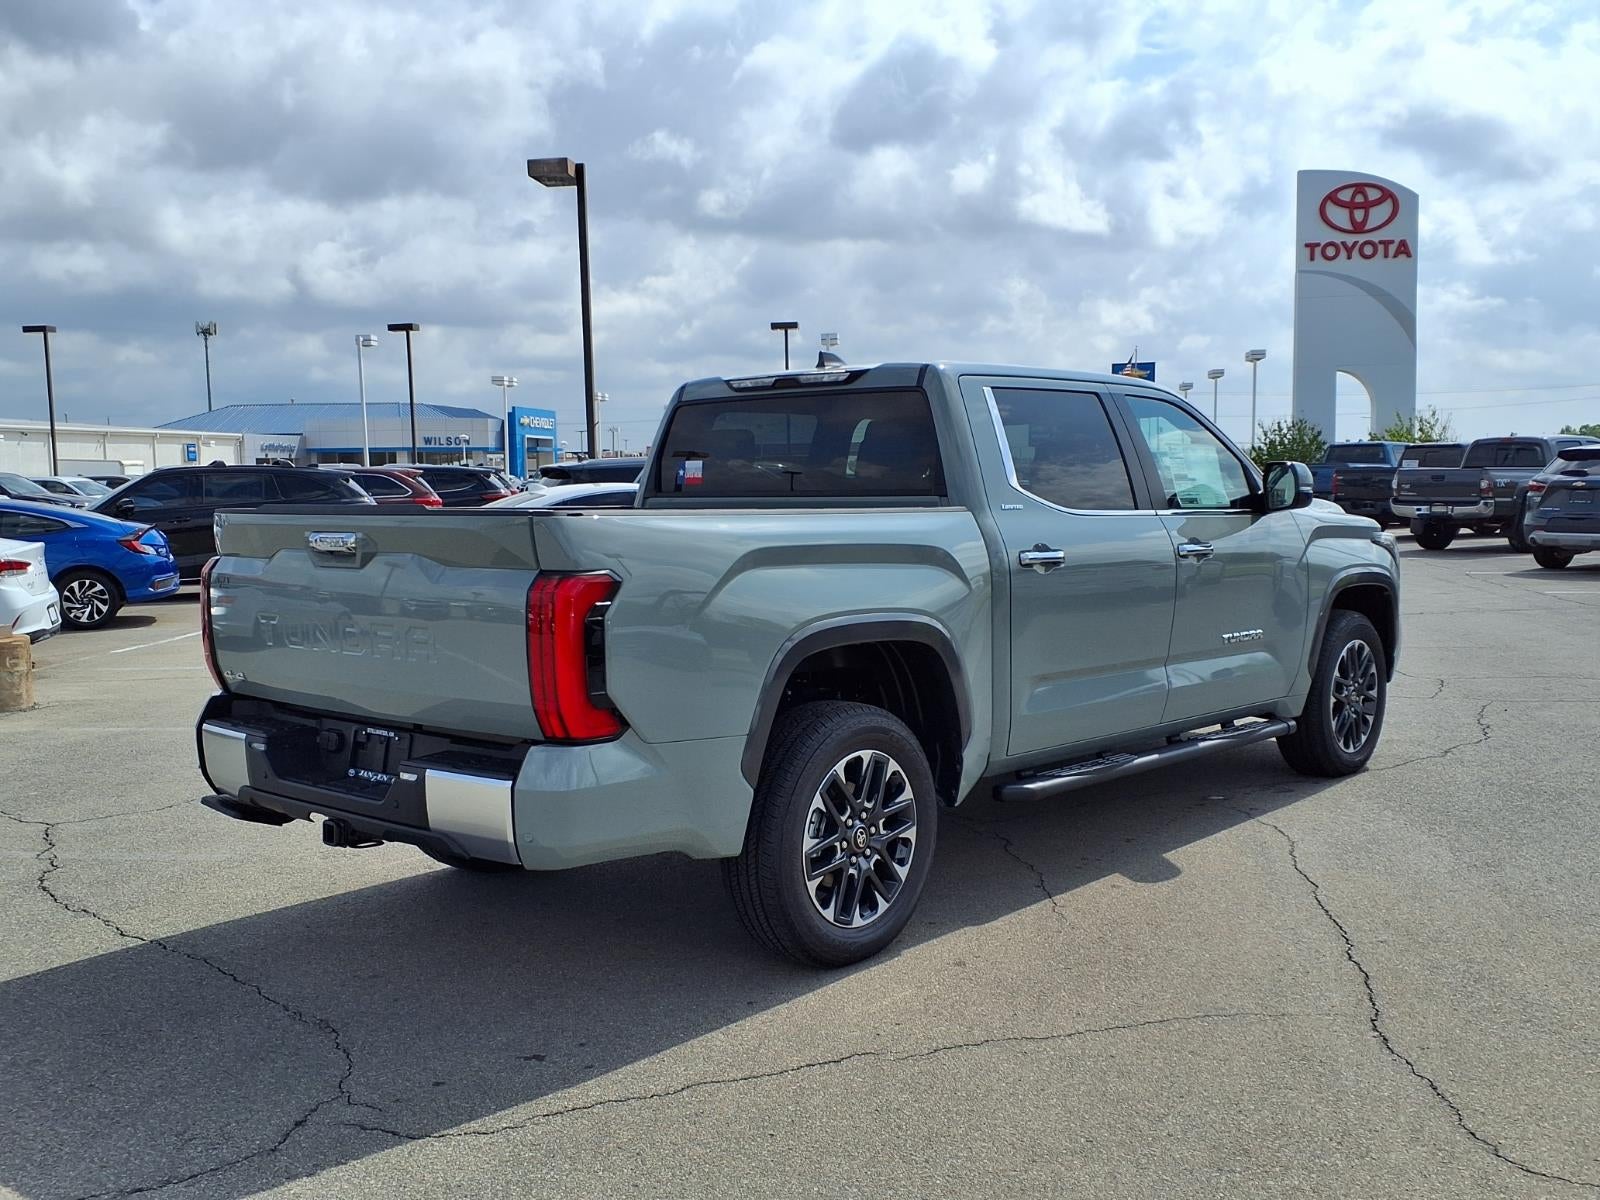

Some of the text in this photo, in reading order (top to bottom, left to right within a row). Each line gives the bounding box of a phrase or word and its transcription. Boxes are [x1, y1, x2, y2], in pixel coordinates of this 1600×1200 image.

[1304, 239, 1412, 261] TOYOTA
[530, 416, 555, 429] CHEVROLET
[256, 610, 438, 664] TUNDRA
[1222, 629, 1263, 645] TUNDRA
